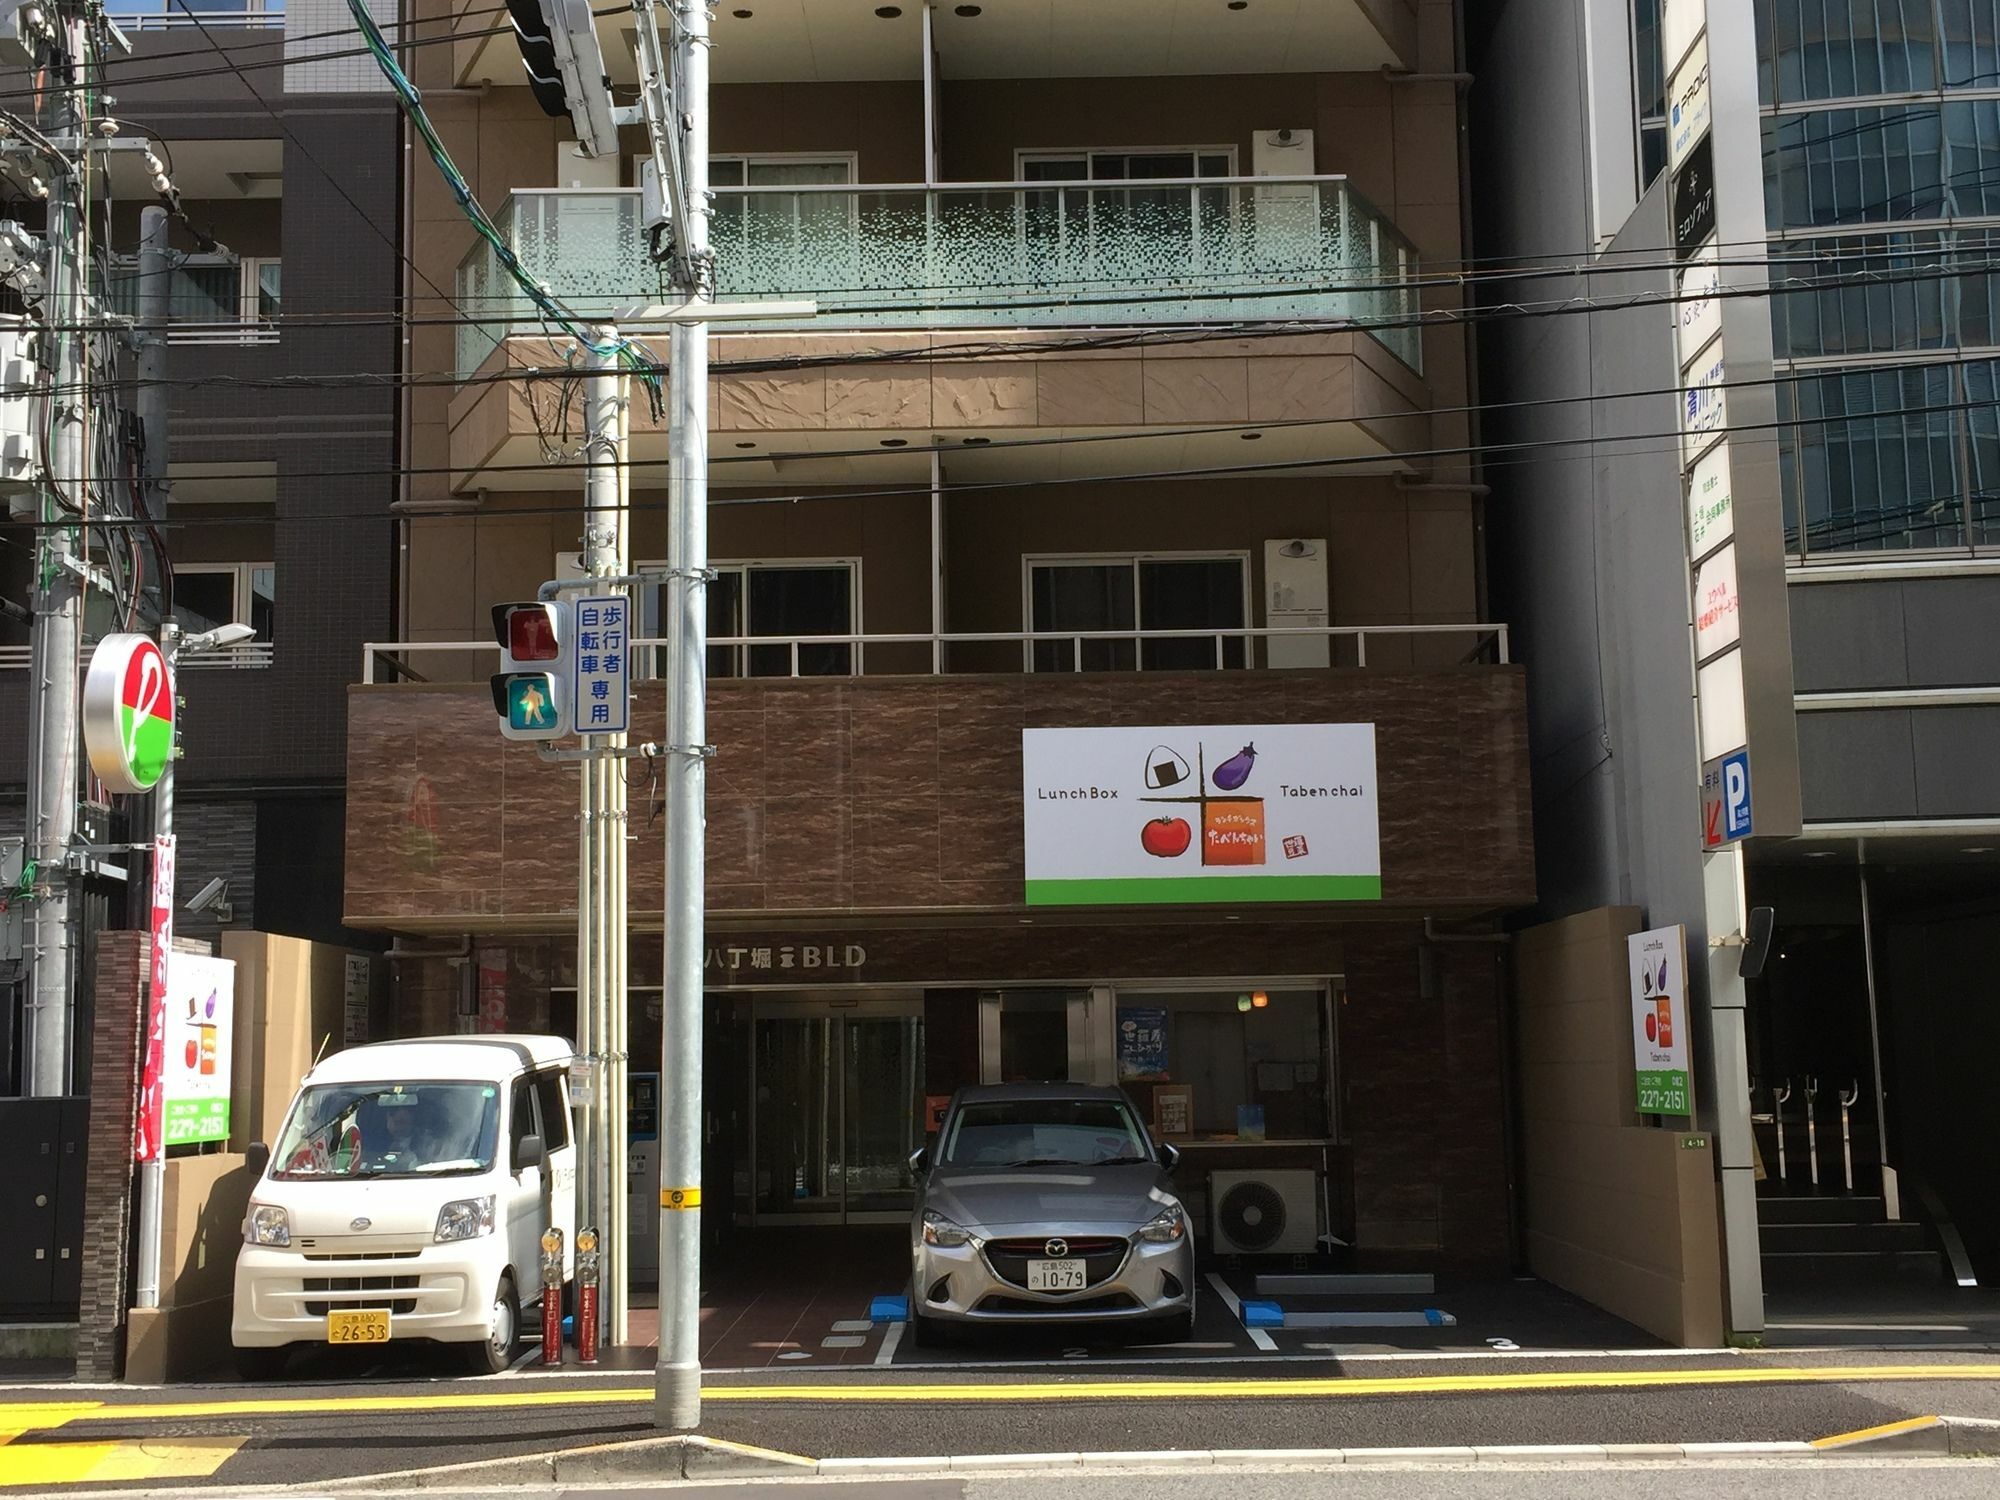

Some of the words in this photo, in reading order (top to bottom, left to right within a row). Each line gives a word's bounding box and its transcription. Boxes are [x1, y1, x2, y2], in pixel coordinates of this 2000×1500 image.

[581, 608, 600, 674] 自転車
[603, 606, 622, 674] 歩行者
[591, 680, 610, 723] 専用
[1280, 785, 1364, 798] Tabenchai
[1726, 761, 1745, 832] P
[704, 947, 771, 968] 八丁堀
[803, 945, 866, 967] BLD
[1640, 1090, 1685, 1110] 227-2151
[1043, 1271, 1083, 1288] 10-79
[342, 1324, 385, 1341] 26-53
